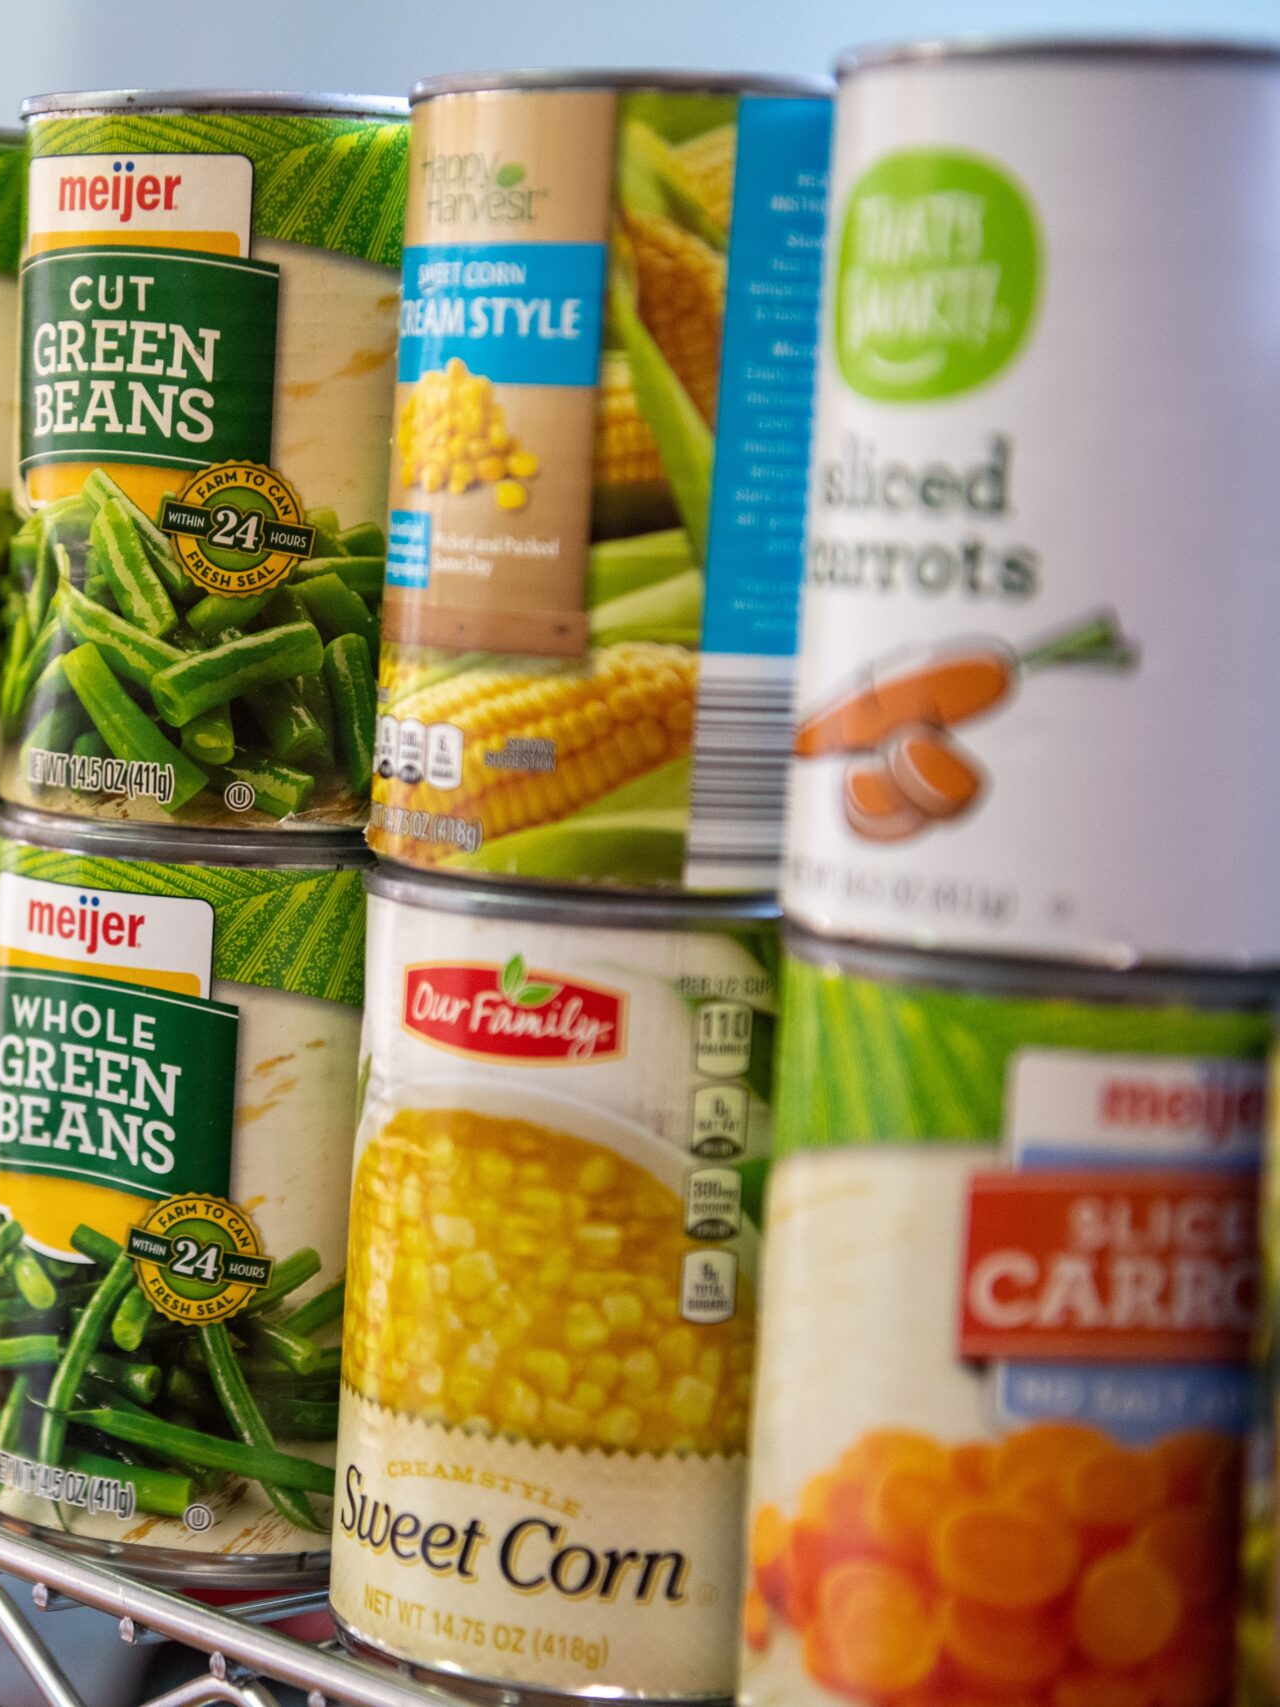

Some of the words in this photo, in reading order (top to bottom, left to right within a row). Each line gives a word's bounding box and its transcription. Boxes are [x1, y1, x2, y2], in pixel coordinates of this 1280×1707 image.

[58, 160, 182, 223] meijer
[427, 186, 537, 224] Harvest
[69, 274, 155, 312] CUT
[418, 260, 463, 286] SWEET
[464, 261, 527, 287] CORN
[470, 297, 582, 339] STYLE
[33, 319, 221, 383] GREEN
[33, 379, 215, 443] BEANS
[195, 470, 238, 500] FARM
[244, 470, 265, 487] TO
[268, 484, 293, 517] CAN
[824, 430, 1011, 520] sliced
[168, 511, 205, 529] WITHIN
[212, 509, 258, 550] 24
[270, 531, 307, 548] HOURS
[186, 550, 232, 587] FRESH
[237, 564, 276, 588] SEAL
[71, 756, 100, 791] 14.5
[103, 760, 125, 792] OZ
[127, 763, 174, 804] (411g)
[485, 752, 557, 773] SUGGESTION
[411, 811, 430, 839] OZ
[432, 816, 483, 853] (418g)
[27, 894, 146, 955] meijer
[680, 975, 714, 996] PER
[11, 994, 156, 1052] WHOLE
[411, 979, 470, 1025] Our
[469, 989, 615, 1061] Family
[703, 1010, 750, 1041] 110
[157, 1203, 197, 1229] FARM
[204, 1203, 224, 1220] TO
[227, 1217, 251, 1250] CAN
[132, 1236, 167, 1257] WITHIN
[172, 1240, 218, 1281] 24
[229, 1262, 266, 1279] HOURS
[149, 1277, 191, 1315] FRESH
[196, 1295, 234, 1316] SEAL
[35, 1464, 63, 1502] 14.5
[64, 1470, 87, 1506] OZ
[88, 1477, 136, 1520] (411g)
[340, 1463, 487, 1583] Sweet
[500, 1517, 690, 1607] Corn
[363, 1583, 391, 1619] NET
[399, 1602, 427, 1629] WT
[432, 1610, 486, 1648] 14.75
[492, 1625, 526, 1655] OZ
[533, 1628, 610, 1670] (418g)
